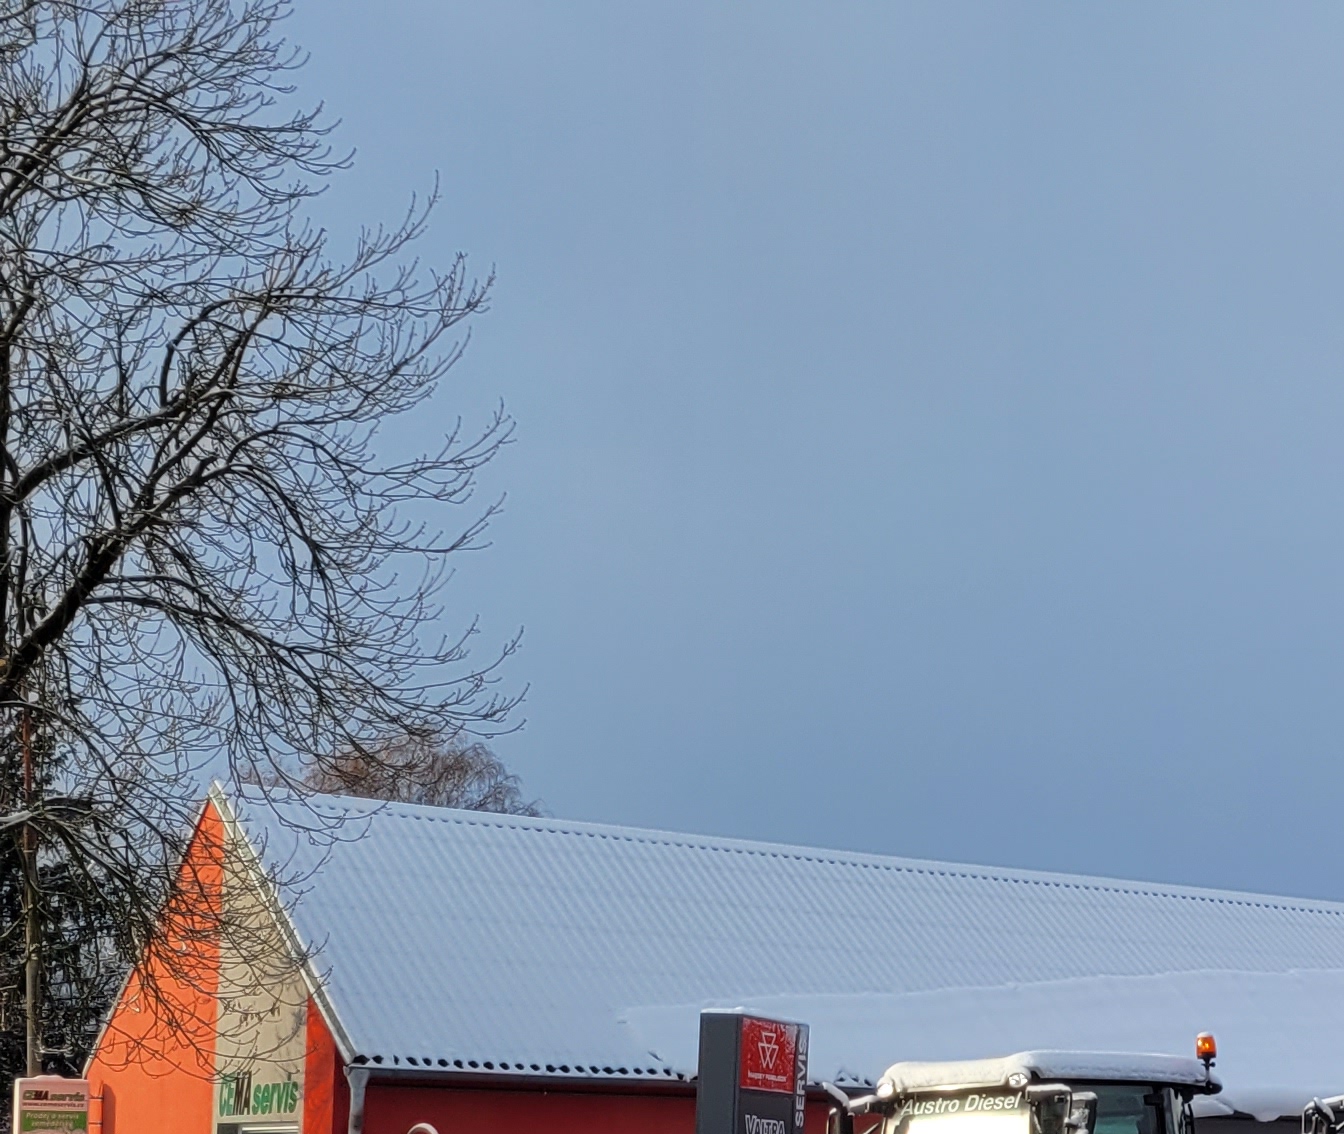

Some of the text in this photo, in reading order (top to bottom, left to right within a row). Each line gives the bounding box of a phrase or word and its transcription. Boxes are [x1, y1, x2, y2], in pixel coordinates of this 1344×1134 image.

[219, 1071, 299, 1117] CEMA servis
[795, 1035, 808, 1128] SERVIS
[900, 1091, 1023, 1116] Austro Diesel
